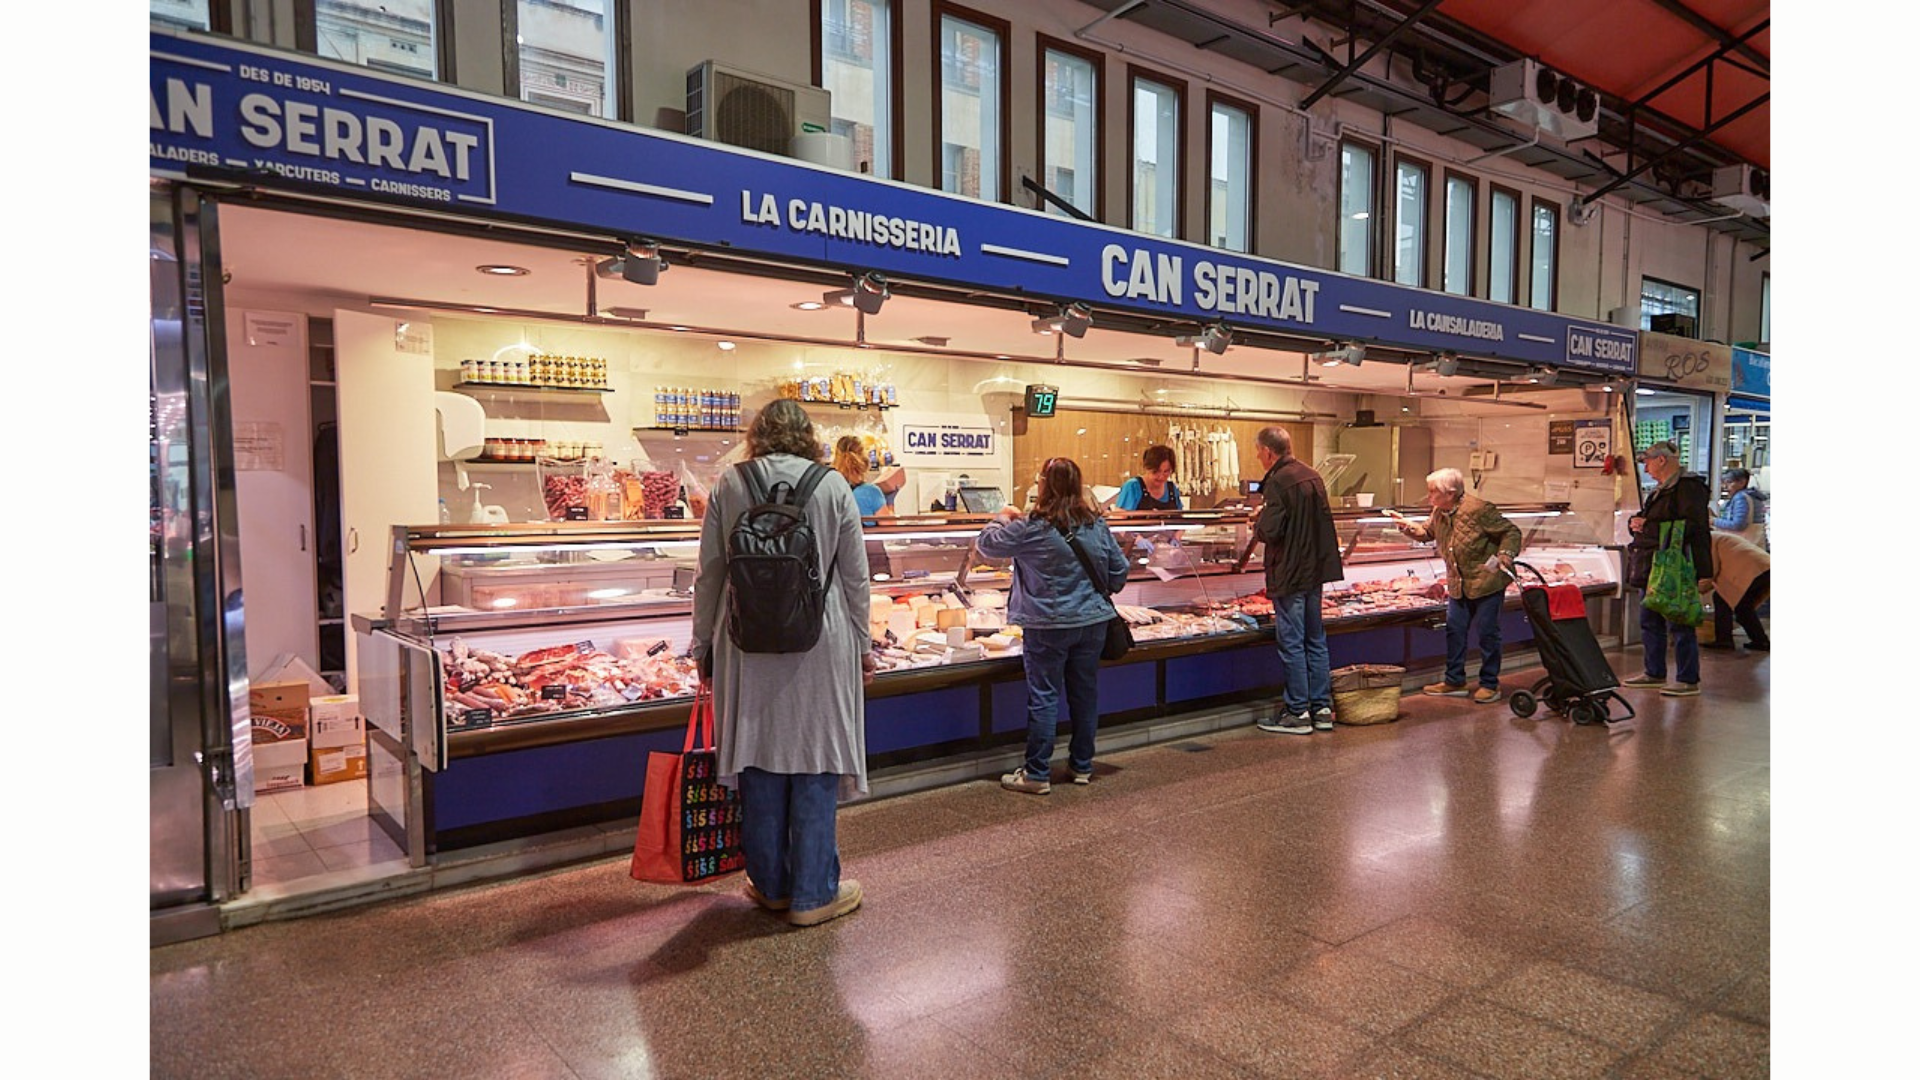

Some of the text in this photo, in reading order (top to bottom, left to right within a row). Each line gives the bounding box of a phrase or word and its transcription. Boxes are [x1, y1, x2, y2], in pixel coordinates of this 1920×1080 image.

[239, 64, 331, 95] DES DE 1954
[239, 93, 478, 181] SERRAT
[371, 178, 451, 202] CARNISSERS
[741, 189, 961, 257] LA CARNISSERIA
[1102, 243, 1319, 324] CAN SERRAT
[1409, 308, 1504, 341] LA CANSALADERIA
[1570, 334, 1593, 358] CAN
[1594, 338, 1632, 363] SERRAT
[1664, 351, 1710, 380] ROS
[1034, 393, 1054, 414] 79
[908, 431, 991, 449] CAN SERRAT
